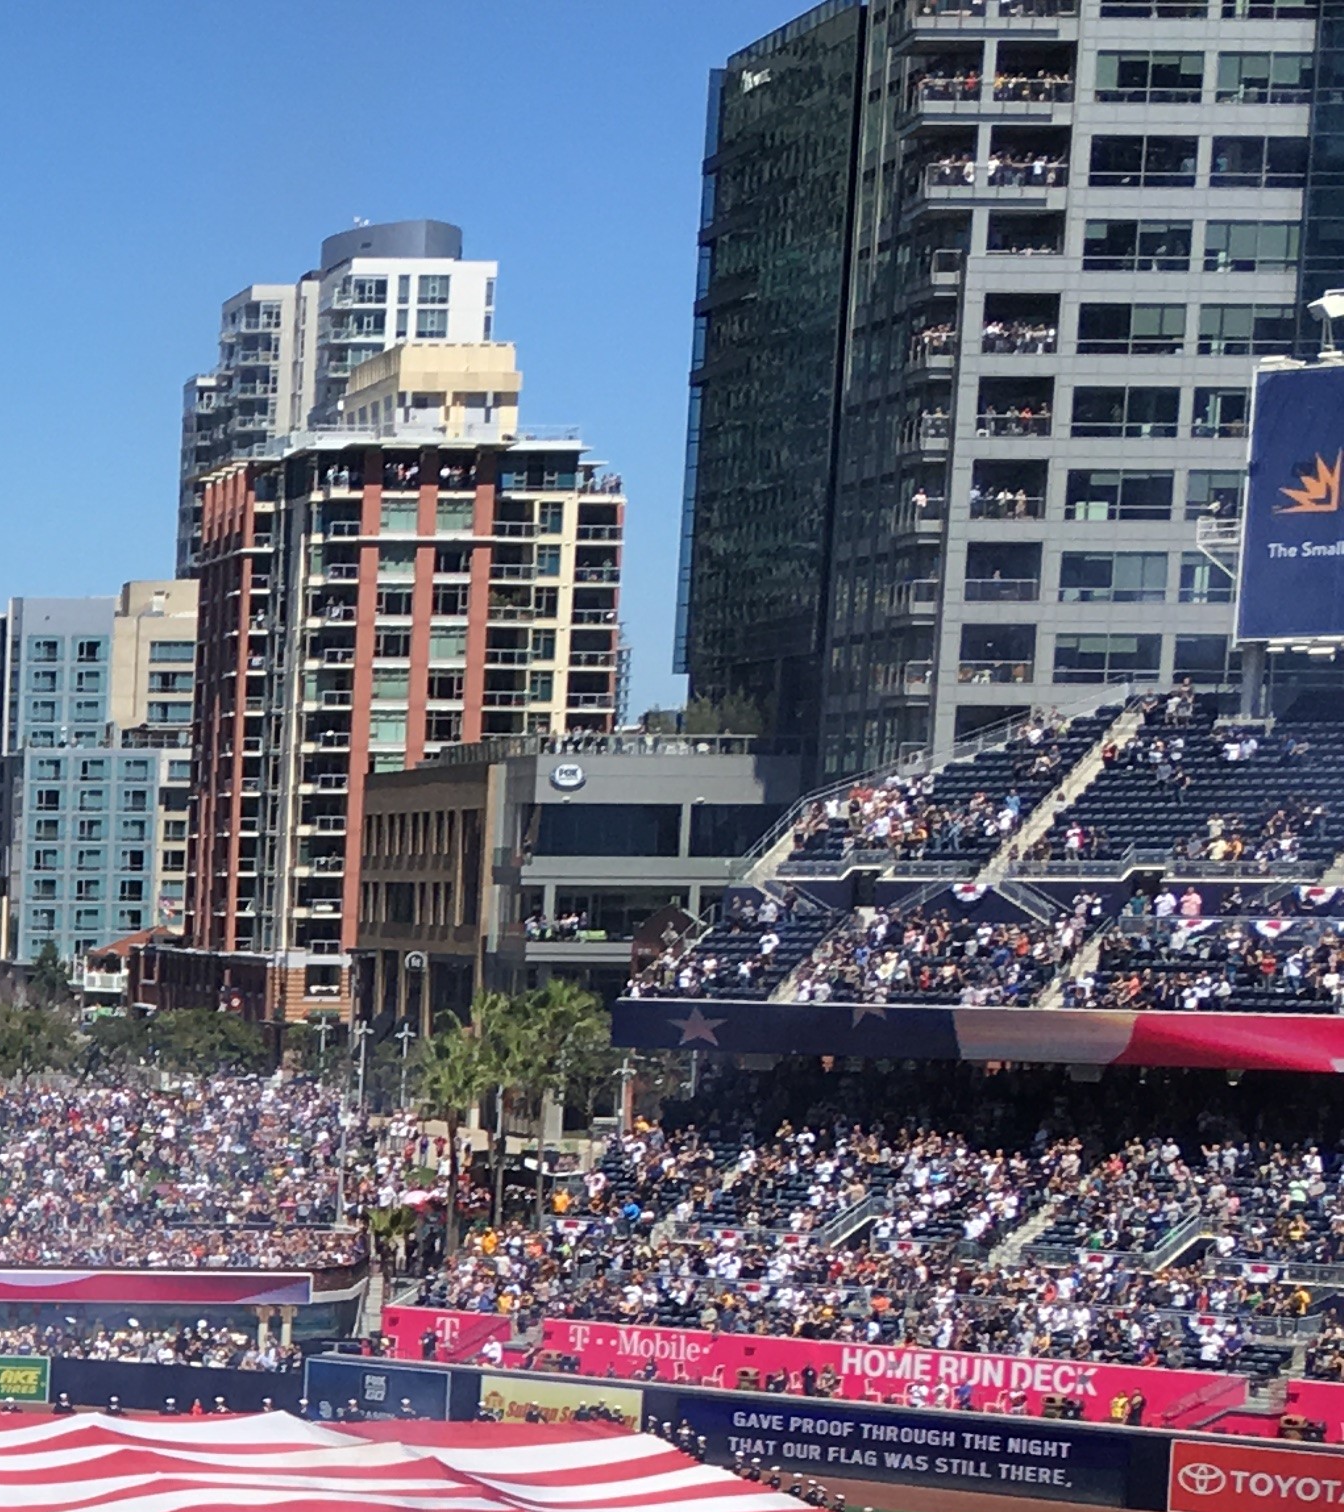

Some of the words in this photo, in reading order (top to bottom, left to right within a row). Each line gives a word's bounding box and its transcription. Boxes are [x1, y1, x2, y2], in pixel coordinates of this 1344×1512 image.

[1267, 542, 1298, 559] The
[0, 1383, 37, 1395] TIRES
[841, 1347, 932, 1382] HOME
[938, 1355, 1005, 1388] RUN
[1010, 1361, 1099, 1396] DECK
[732, 1411, 784, 1432] GAVE
[788, 1415, 855, 1438] PROOF
[859, 1422, 956, 1448] THROUGH
[961, 1432, 1001, 1452] THE
[1006, 1436, 1072, 1459] NIGHT
[727, 1436, 777, 1456] THAT
[782, 1441, 822, 1462] OUR
[826, 1445, 879, 1467] FLAG
[883, 1451, 929, 1473] WAS
[934, 1456, 993, 1480] STILL
[997, 1463, 1073, 1488] THERE.
